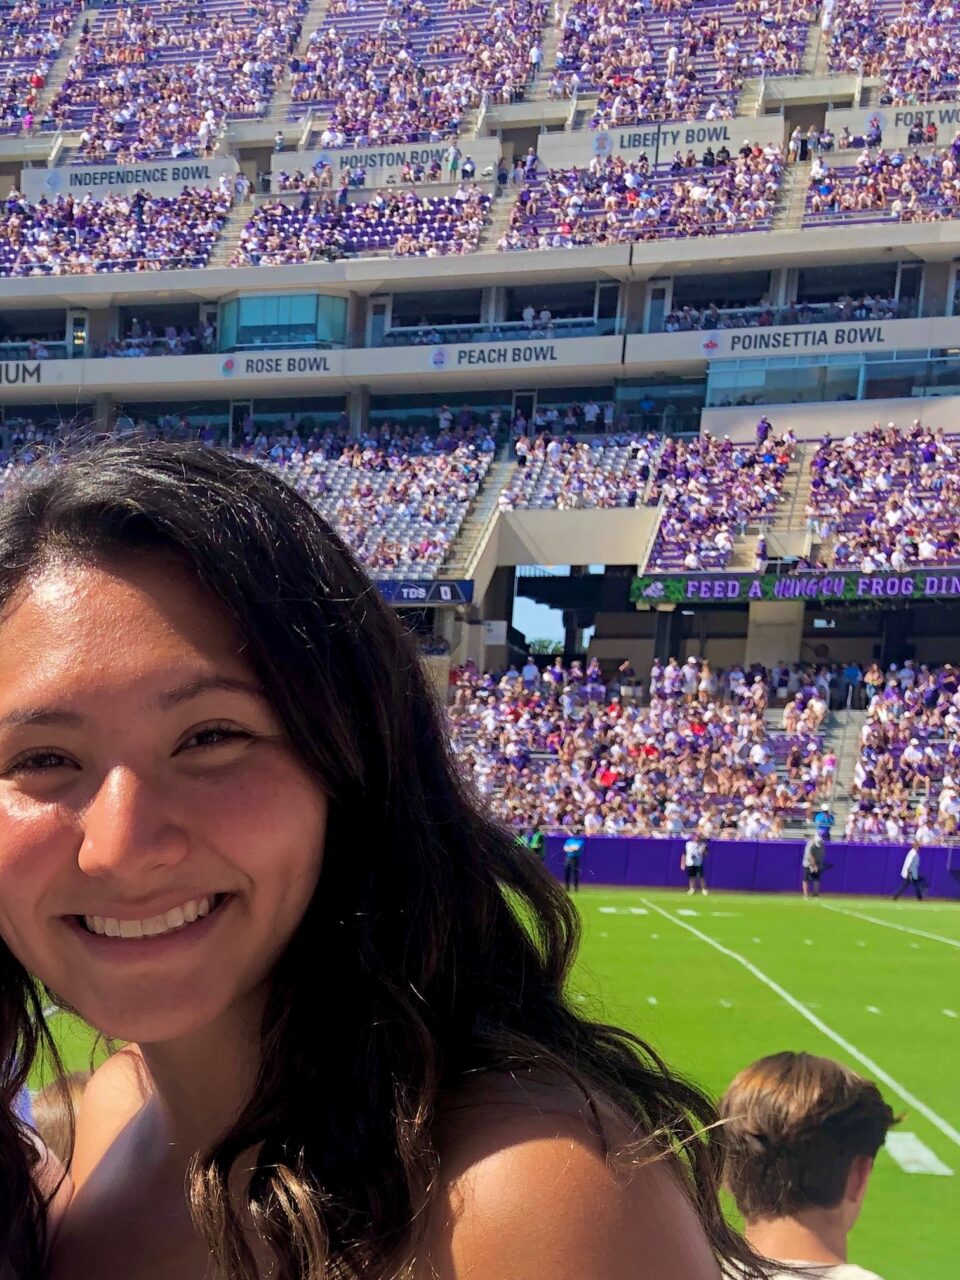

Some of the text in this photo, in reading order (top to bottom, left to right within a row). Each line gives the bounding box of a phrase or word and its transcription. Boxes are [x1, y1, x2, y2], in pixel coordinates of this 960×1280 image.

[894, 110, 934, 127] FORT
[620, 126, 730, 149] LIBERTY BOWL
[340, 148, 448, 169] HOUSTON BOW
[70, 166, 211, 187] INDEPENDENCE BOWL
[730, 327, 885, 351] POINSETTIA BOWL
[245, 356, 330, 374] ROSE BOWL
[457, 346, 557, 365] PEACH BOWL
[401, 586, 451, 600] TDS 0
[686, 580, 739, 598] FEED
[748, 580, 762, 598] A
[774, 576, 846, 599] HUNGRY
[856, 577, 913, 596] FROG
